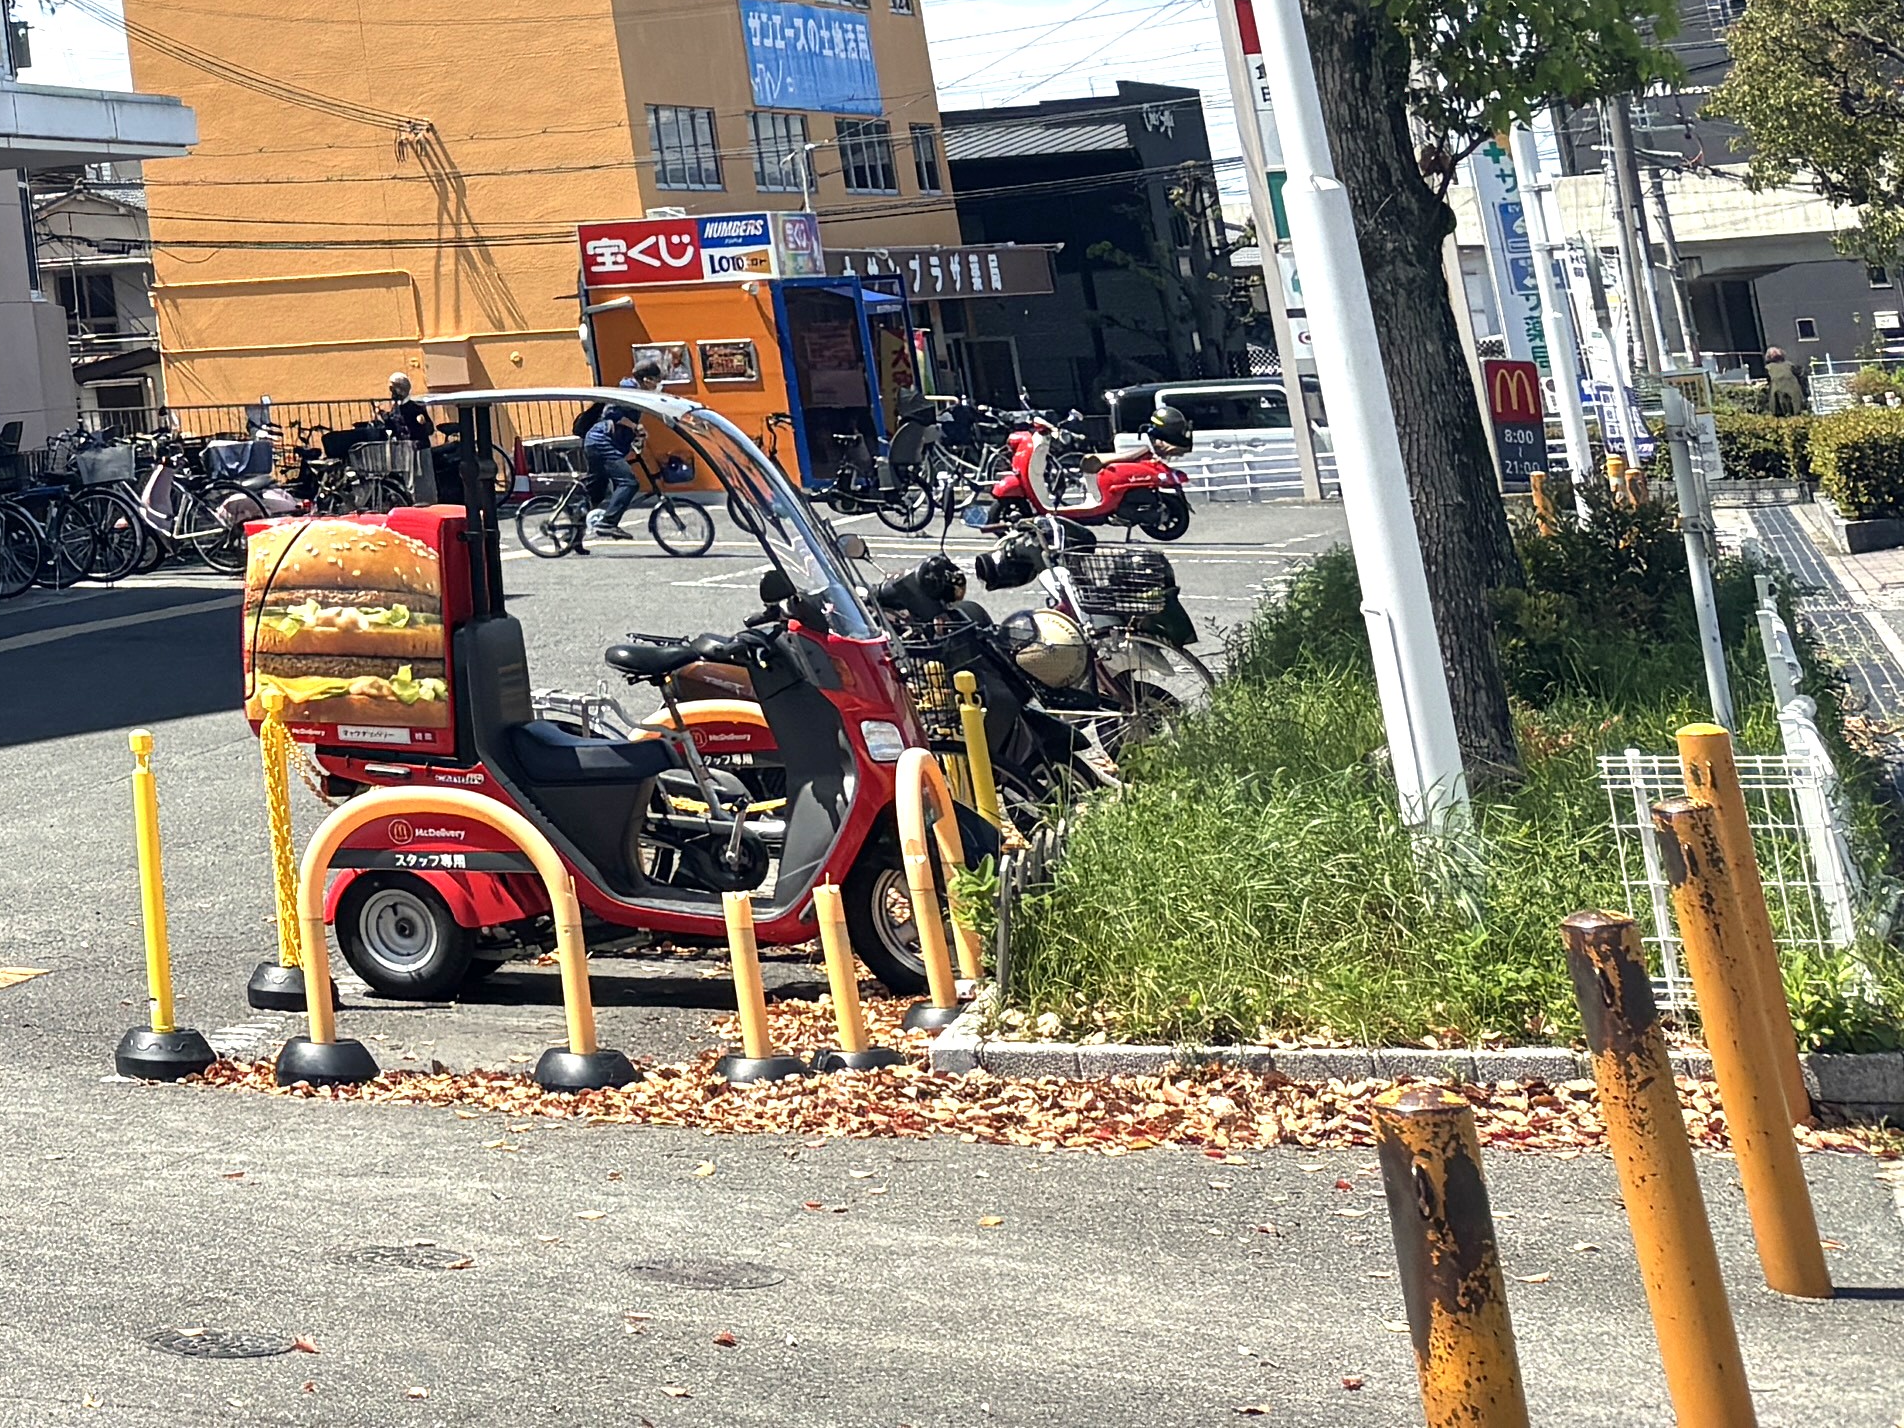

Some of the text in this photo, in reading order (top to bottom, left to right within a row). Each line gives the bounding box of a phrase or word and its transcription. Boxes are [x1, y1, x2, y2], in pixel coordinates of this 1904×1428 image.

[703, 219, 765, 239] NUMBERS
[585, 234, 695, 274] 宝くじ
[708, 254, 745, 275] LOTO
[1504, 428, 1534, 445] 8:00
[708, 733, 752, 742] McDelivery
[703, 753, 754, 766] タッフ専用
[414, 827, 466, 842] McDelivery
[394, 853, 466, 869] スタッフ専用
